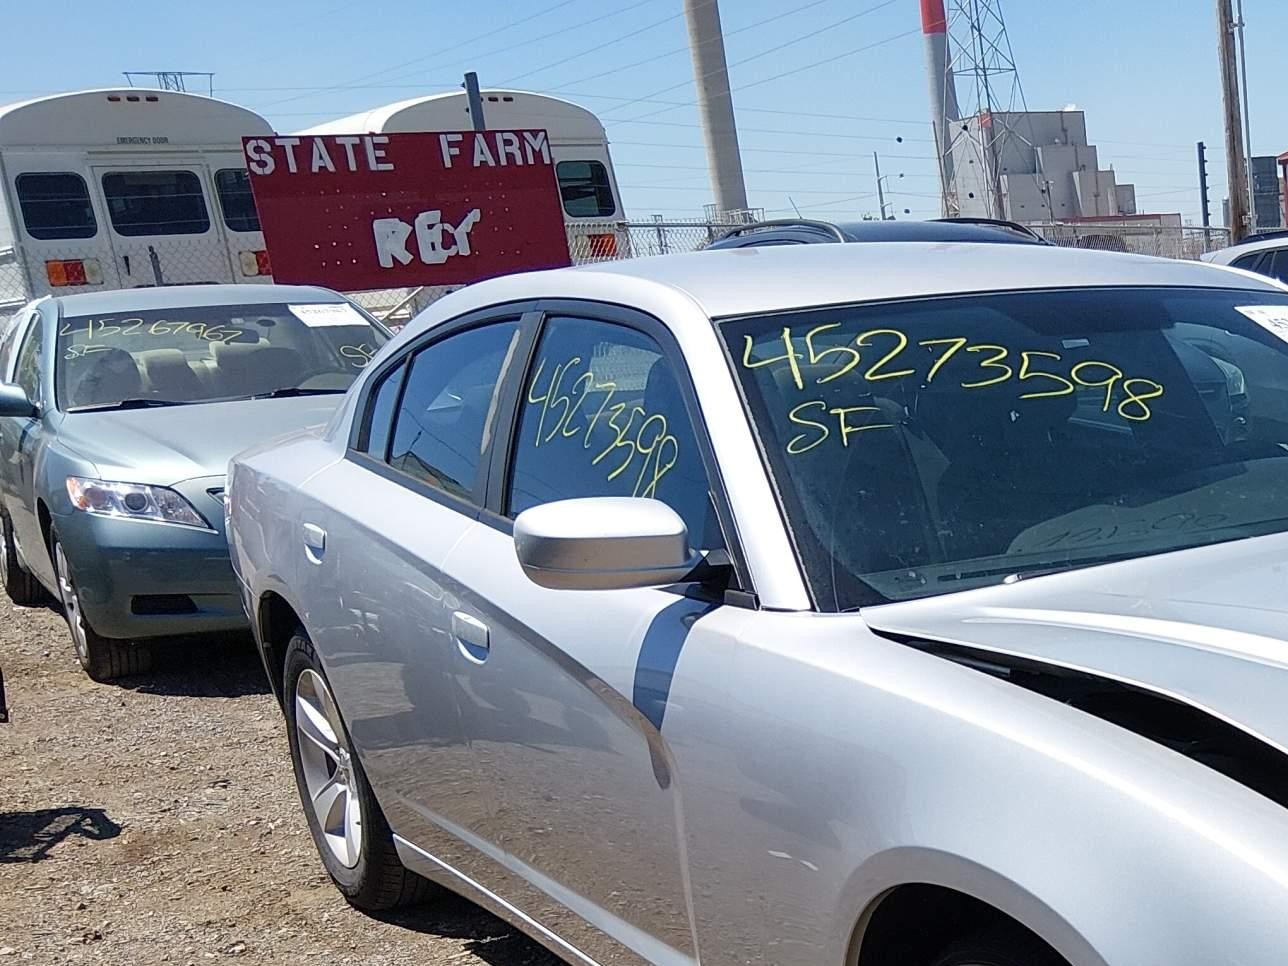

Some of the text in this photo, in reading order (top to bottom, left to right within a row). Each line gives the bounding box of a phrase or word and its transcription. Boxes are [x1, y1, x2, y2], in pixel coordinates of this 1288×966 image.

[245, 131, 552, 177] STATE FARM
[59, 318, 243, 345] 45267967
[64, 344, 113, 360] SF
[742, 322, 1165, 421] 45273598
[527, 357, 679, 499] 45273598
[785, 400, 899, 455] SF
